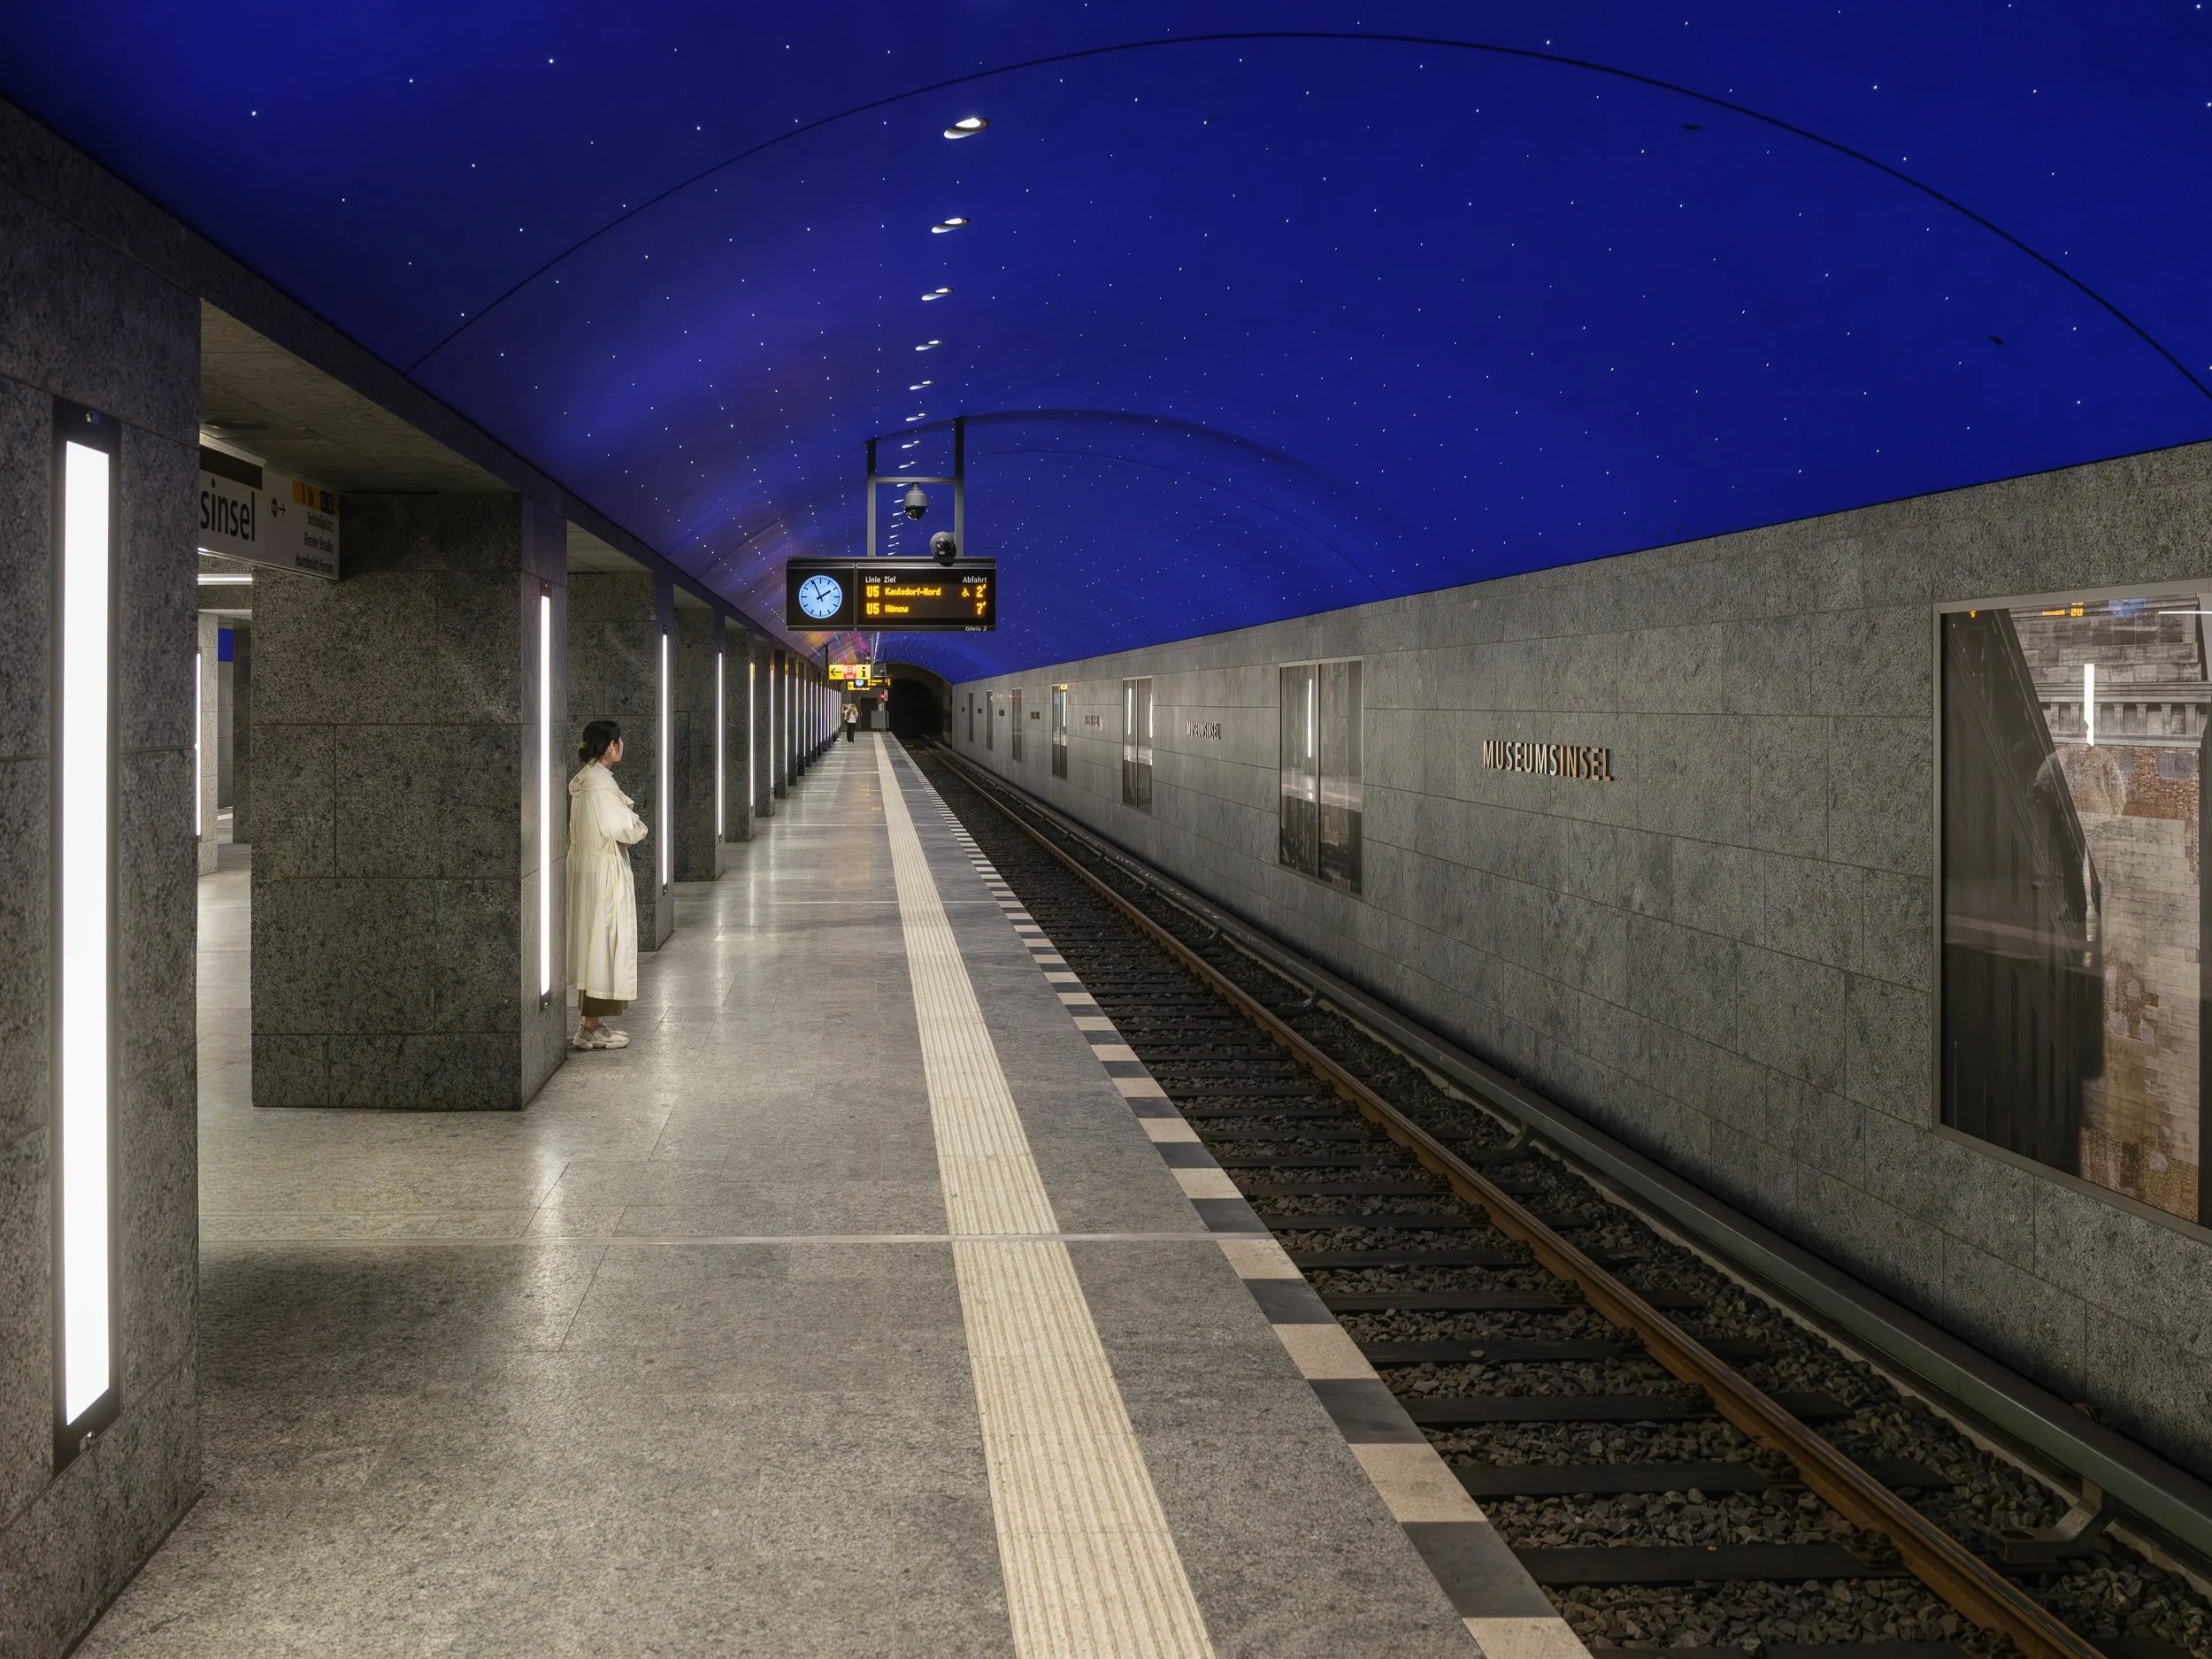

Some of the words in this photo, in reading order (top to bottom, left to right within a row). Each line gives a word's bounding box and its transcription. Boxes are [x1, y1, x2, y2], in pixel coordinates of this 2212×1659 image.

[866, 585, 879, 598] U5
[885, 587, 941, 596] Kaulsdorf-Nord
[866, 603, 879, 615] U5
[885, 604, 909, 613] Hönow
[1483, 740, 1612, 782] MUSEUMSINSEL
